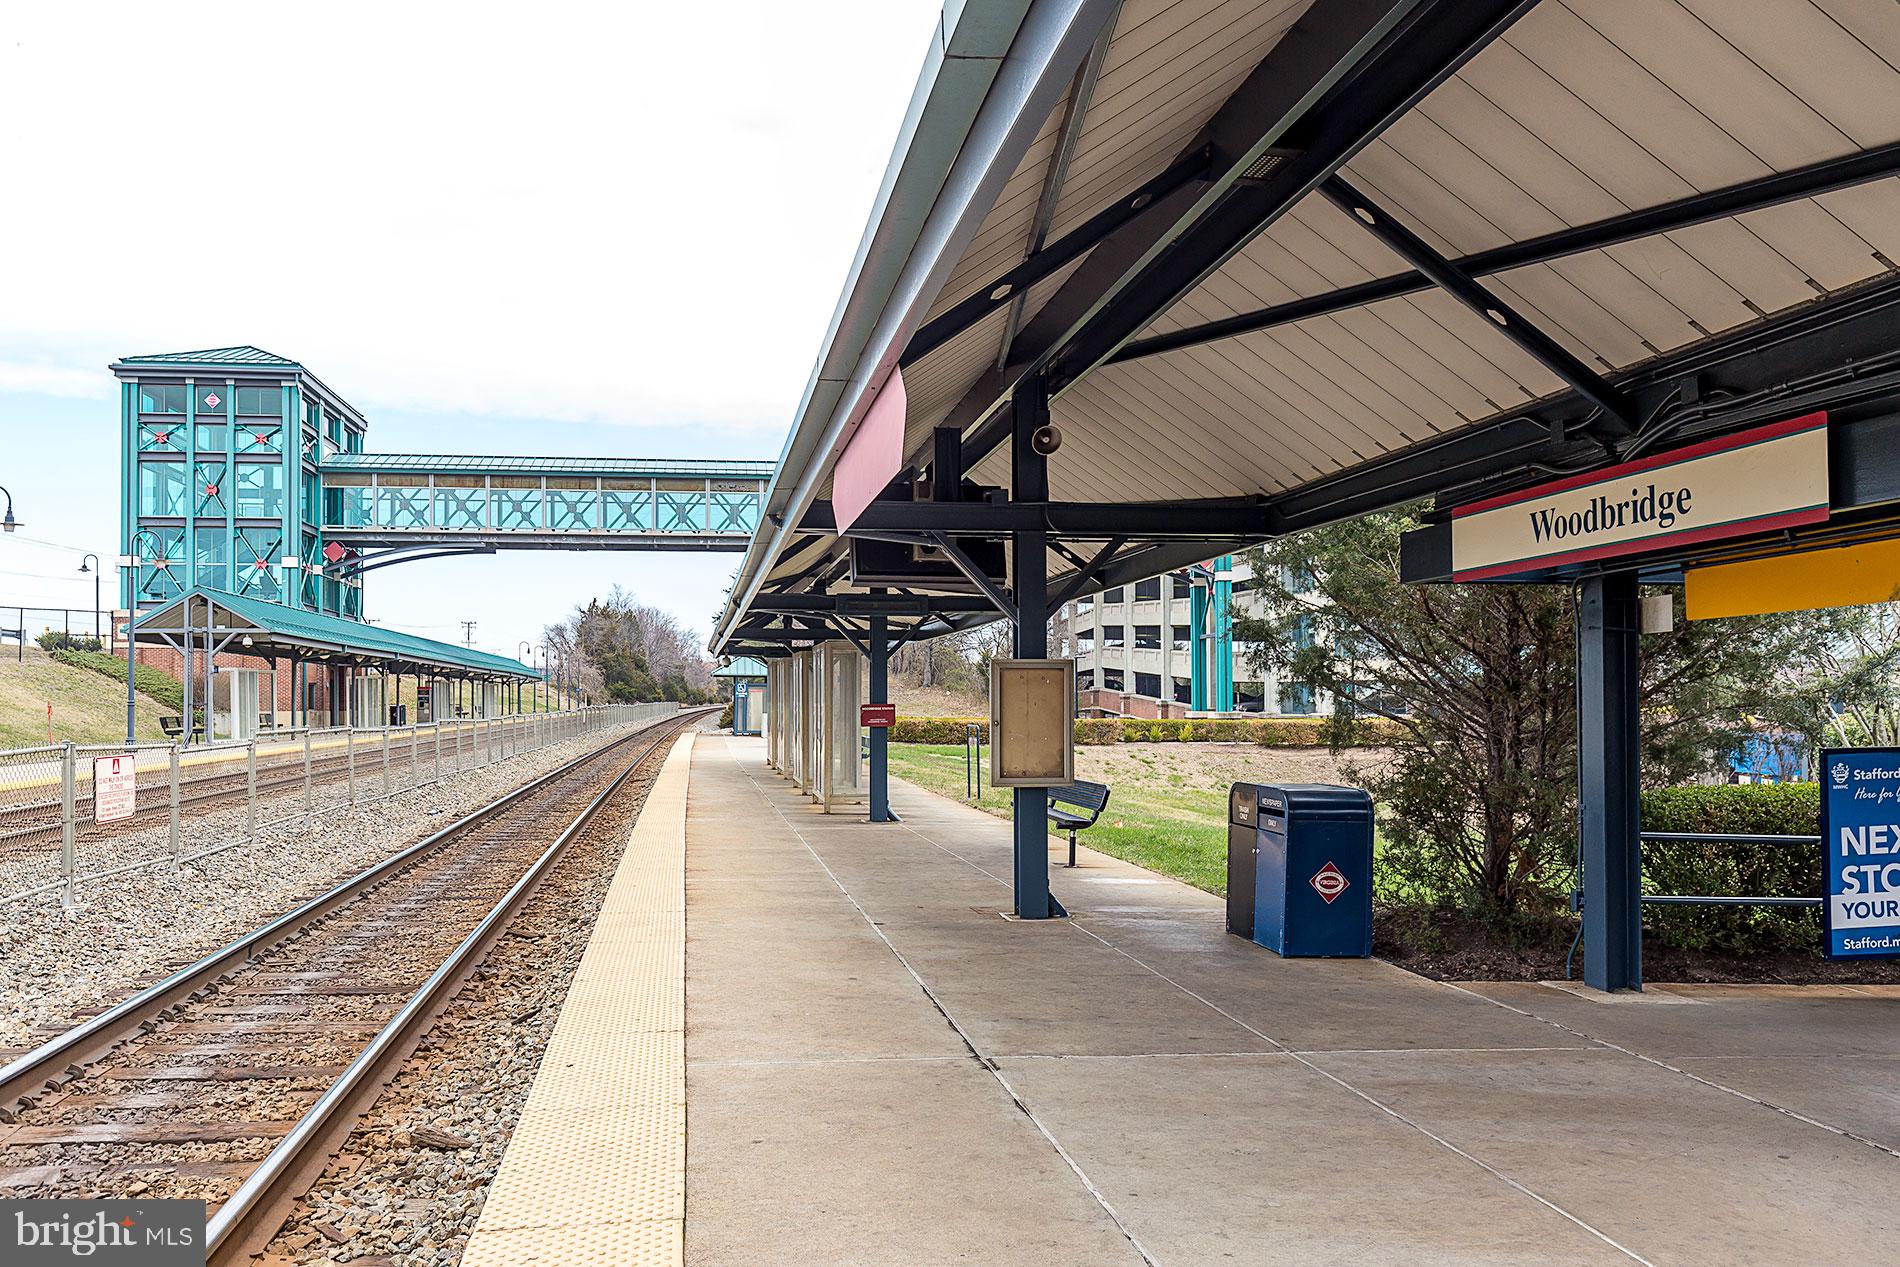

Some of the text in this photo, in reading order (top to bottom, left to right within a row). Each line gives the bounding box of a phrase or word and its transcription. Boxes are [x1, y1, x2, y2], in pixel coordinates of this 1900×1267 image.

[1530, 485, 1692, 543] Woodbridge
[1854, 767, 1900, 781] Stafford
[1854, 786, 1878, 800] Here
[1877, 786, 1894, 804] for
[1261, 797, 1283, 808] NEWSPAPER
[1238, 805, 1250, 814] TRASH
[1239, 812, 1248, 821] ONLY
[1267, 818, 1277, 827] ONLY
[1841, 901, 1900, 919] YOUR
